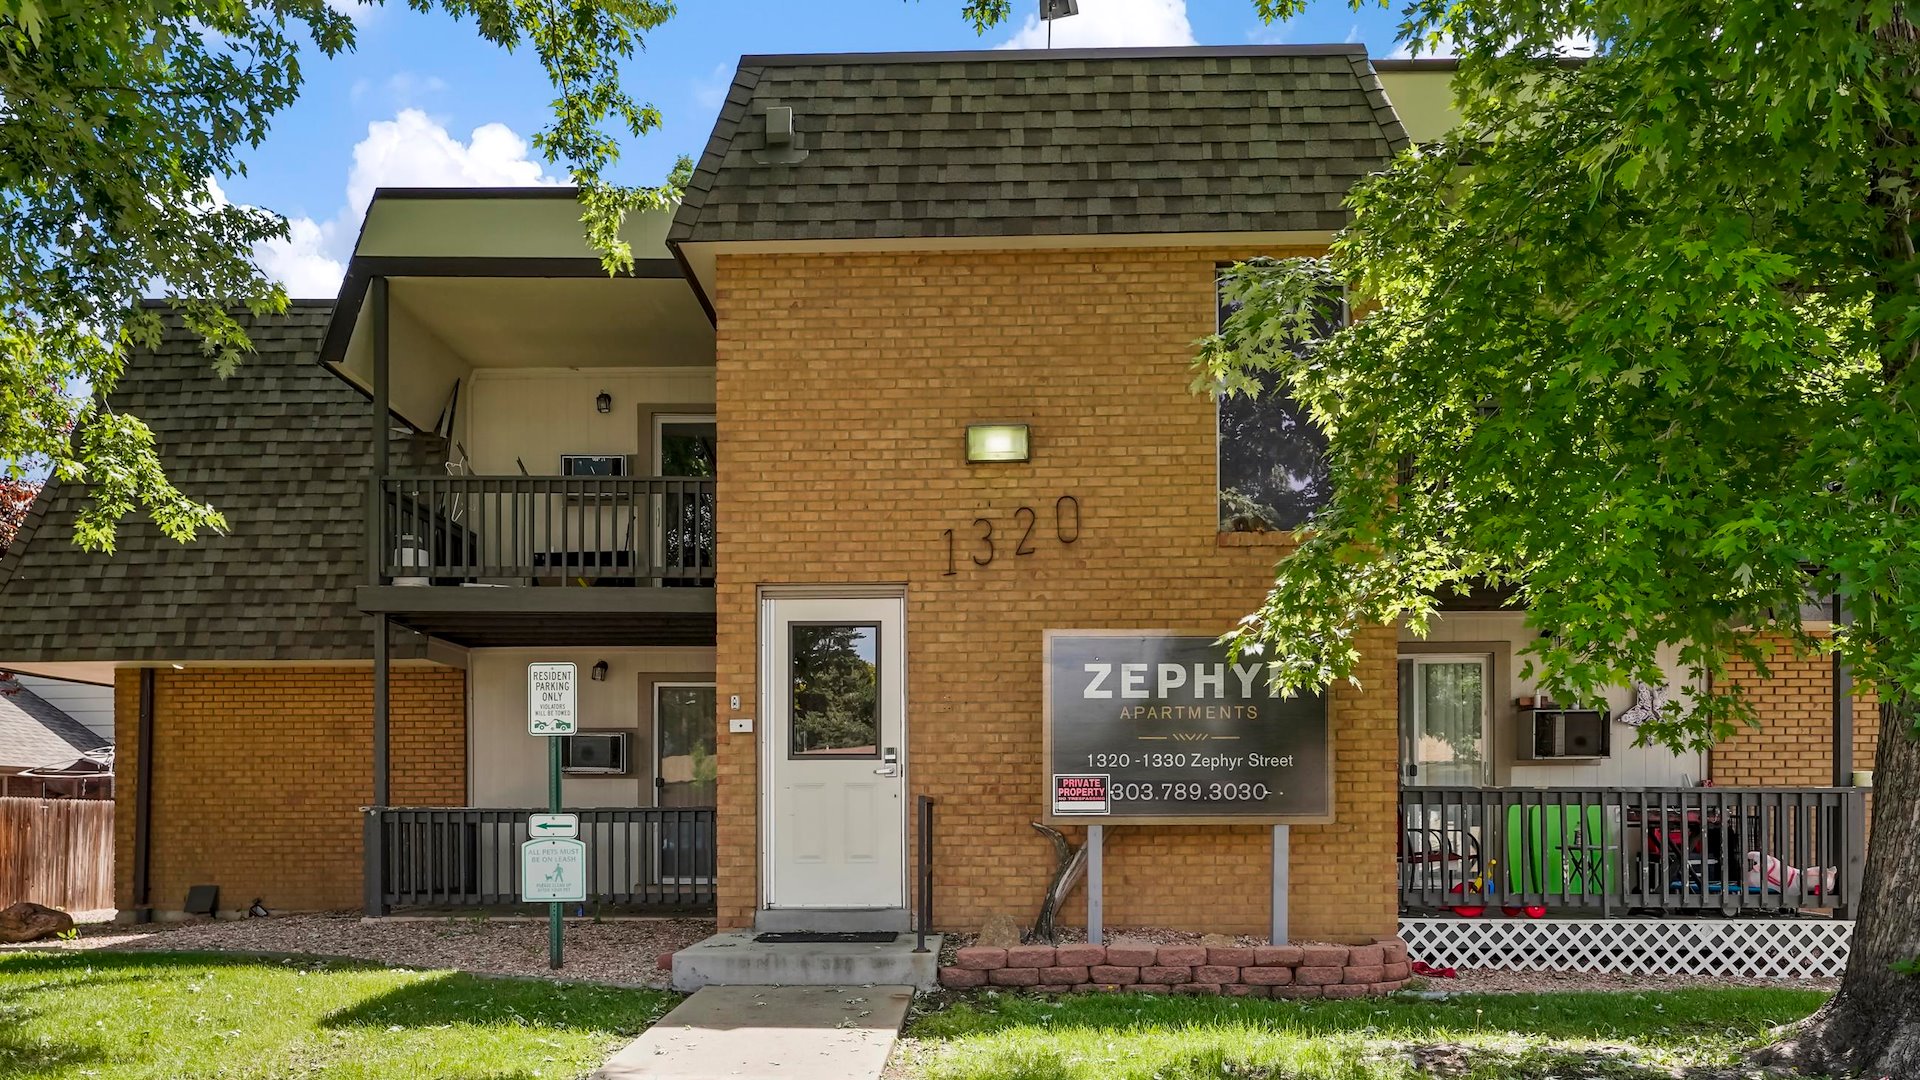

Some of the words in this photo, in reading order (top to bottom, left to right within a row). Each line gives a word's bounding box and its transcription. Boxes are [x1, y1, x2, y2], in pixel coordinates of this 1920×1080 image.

[942, 495, 1079, 576] 1320
[533, 671, 571, 681] RESIDENT
[535, 681, 570, 691] PARKING
[542, 692, 563, 702] ONLY
[1119, 705, 1258, 720] APARTMENTS
[1087, 753, 1130, 767] 1320
[1190, 753, 1243, 771] Zephyr
[1248, 752, 1294, 767] Street
[1062, 778, 1101, 787] PRIVATE
[1058, 787, 1105, 797] PROPERTY
[1111, 783, 1267, 801] 303.789.3030
